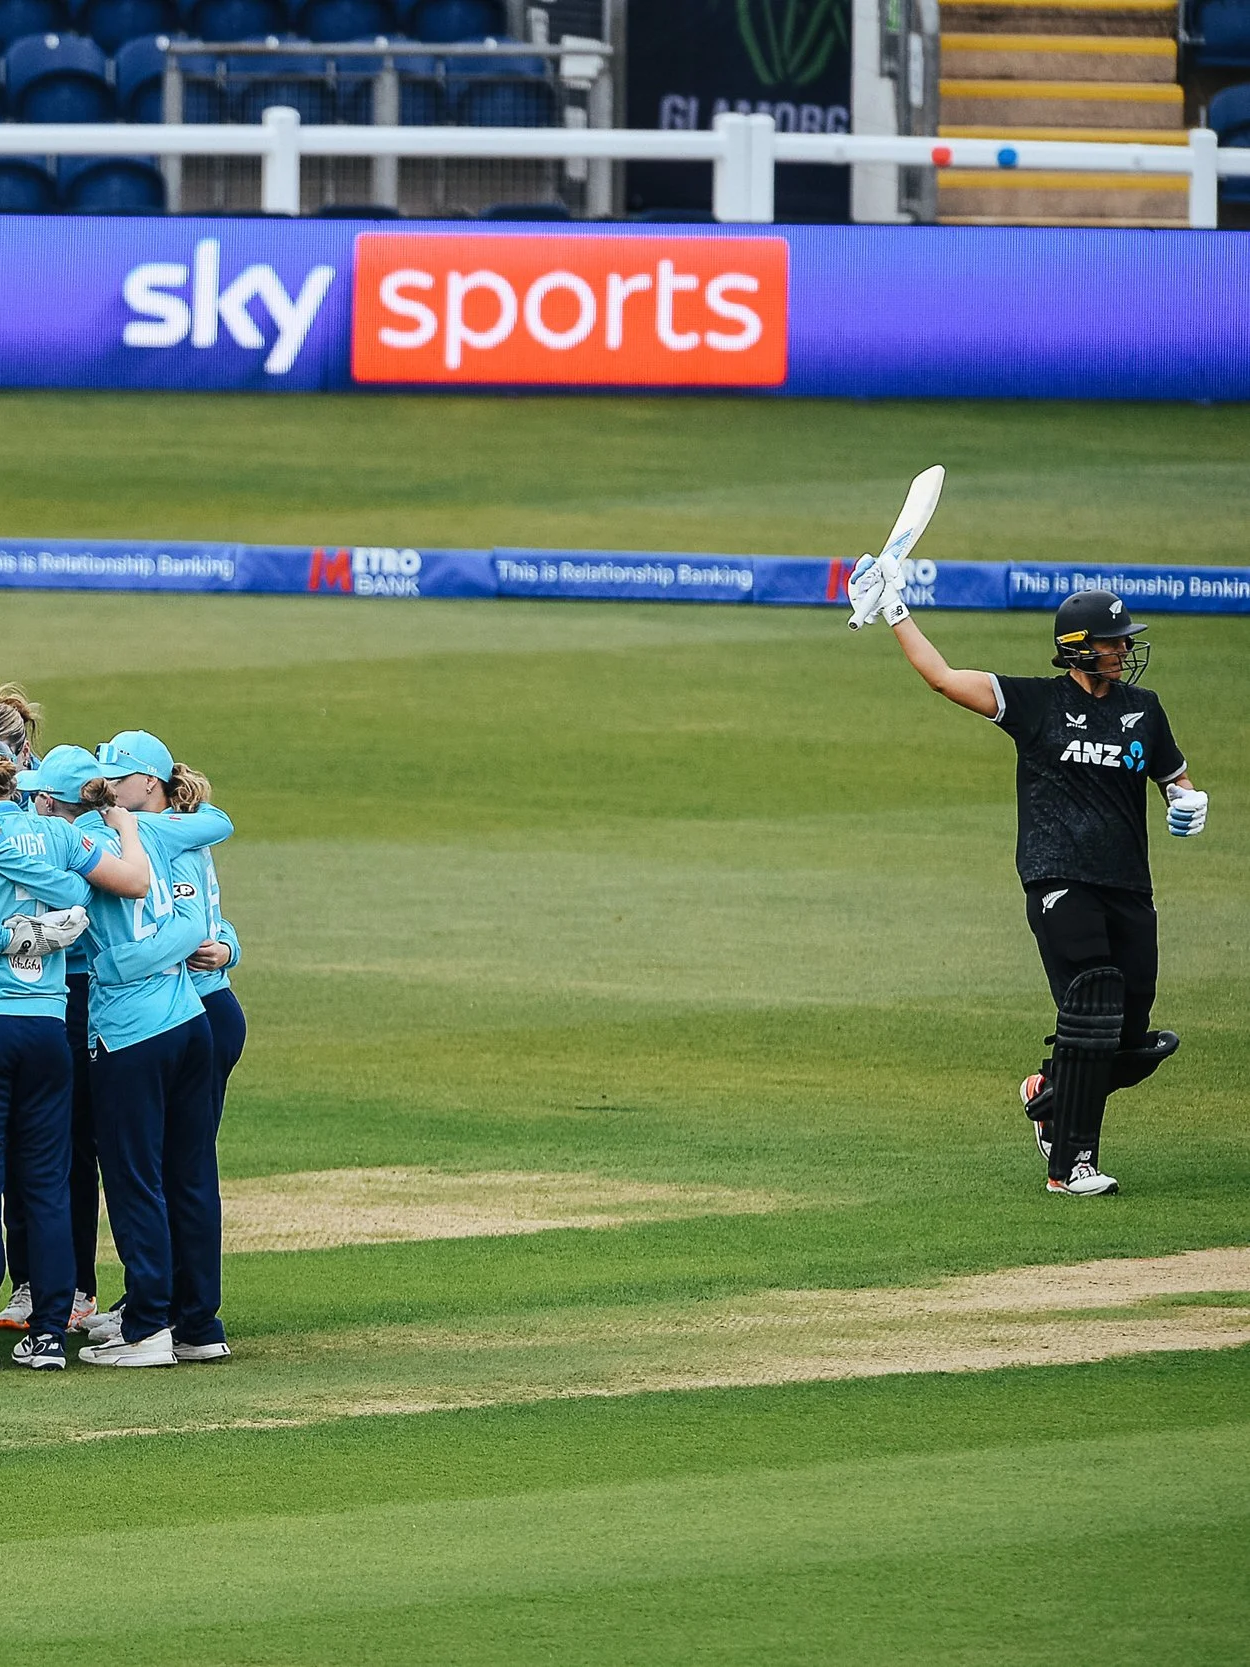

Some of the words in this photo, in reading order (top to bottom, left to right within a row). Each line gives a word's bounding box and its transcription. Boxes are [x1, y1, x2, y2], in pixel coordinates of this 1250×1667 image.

[123, 238, 335, 374] sky
[379, 259, 763, 369] sports
[19, 551, 37, 574] is
[39, 552, 156, 580] Relationship
[157, 555, 232, 582] Banking
[496, 561, 538, 581] This
[541, 561, 558, 582] is
[559, 561, 673, 588] Relationship
[677, 564, 753, 591] Banking
[354, 574, 419, 597] BANK
[1011, 572, 1049, 593] This
[1053, 573, 1070, 593] is
[1072, 573, 1184, 600] Relationship
[1190, 577, 1250, 598] Bankin
[1059, 740, 1122, 767] ANZ
[9, 954, 41, 973] Vitality
